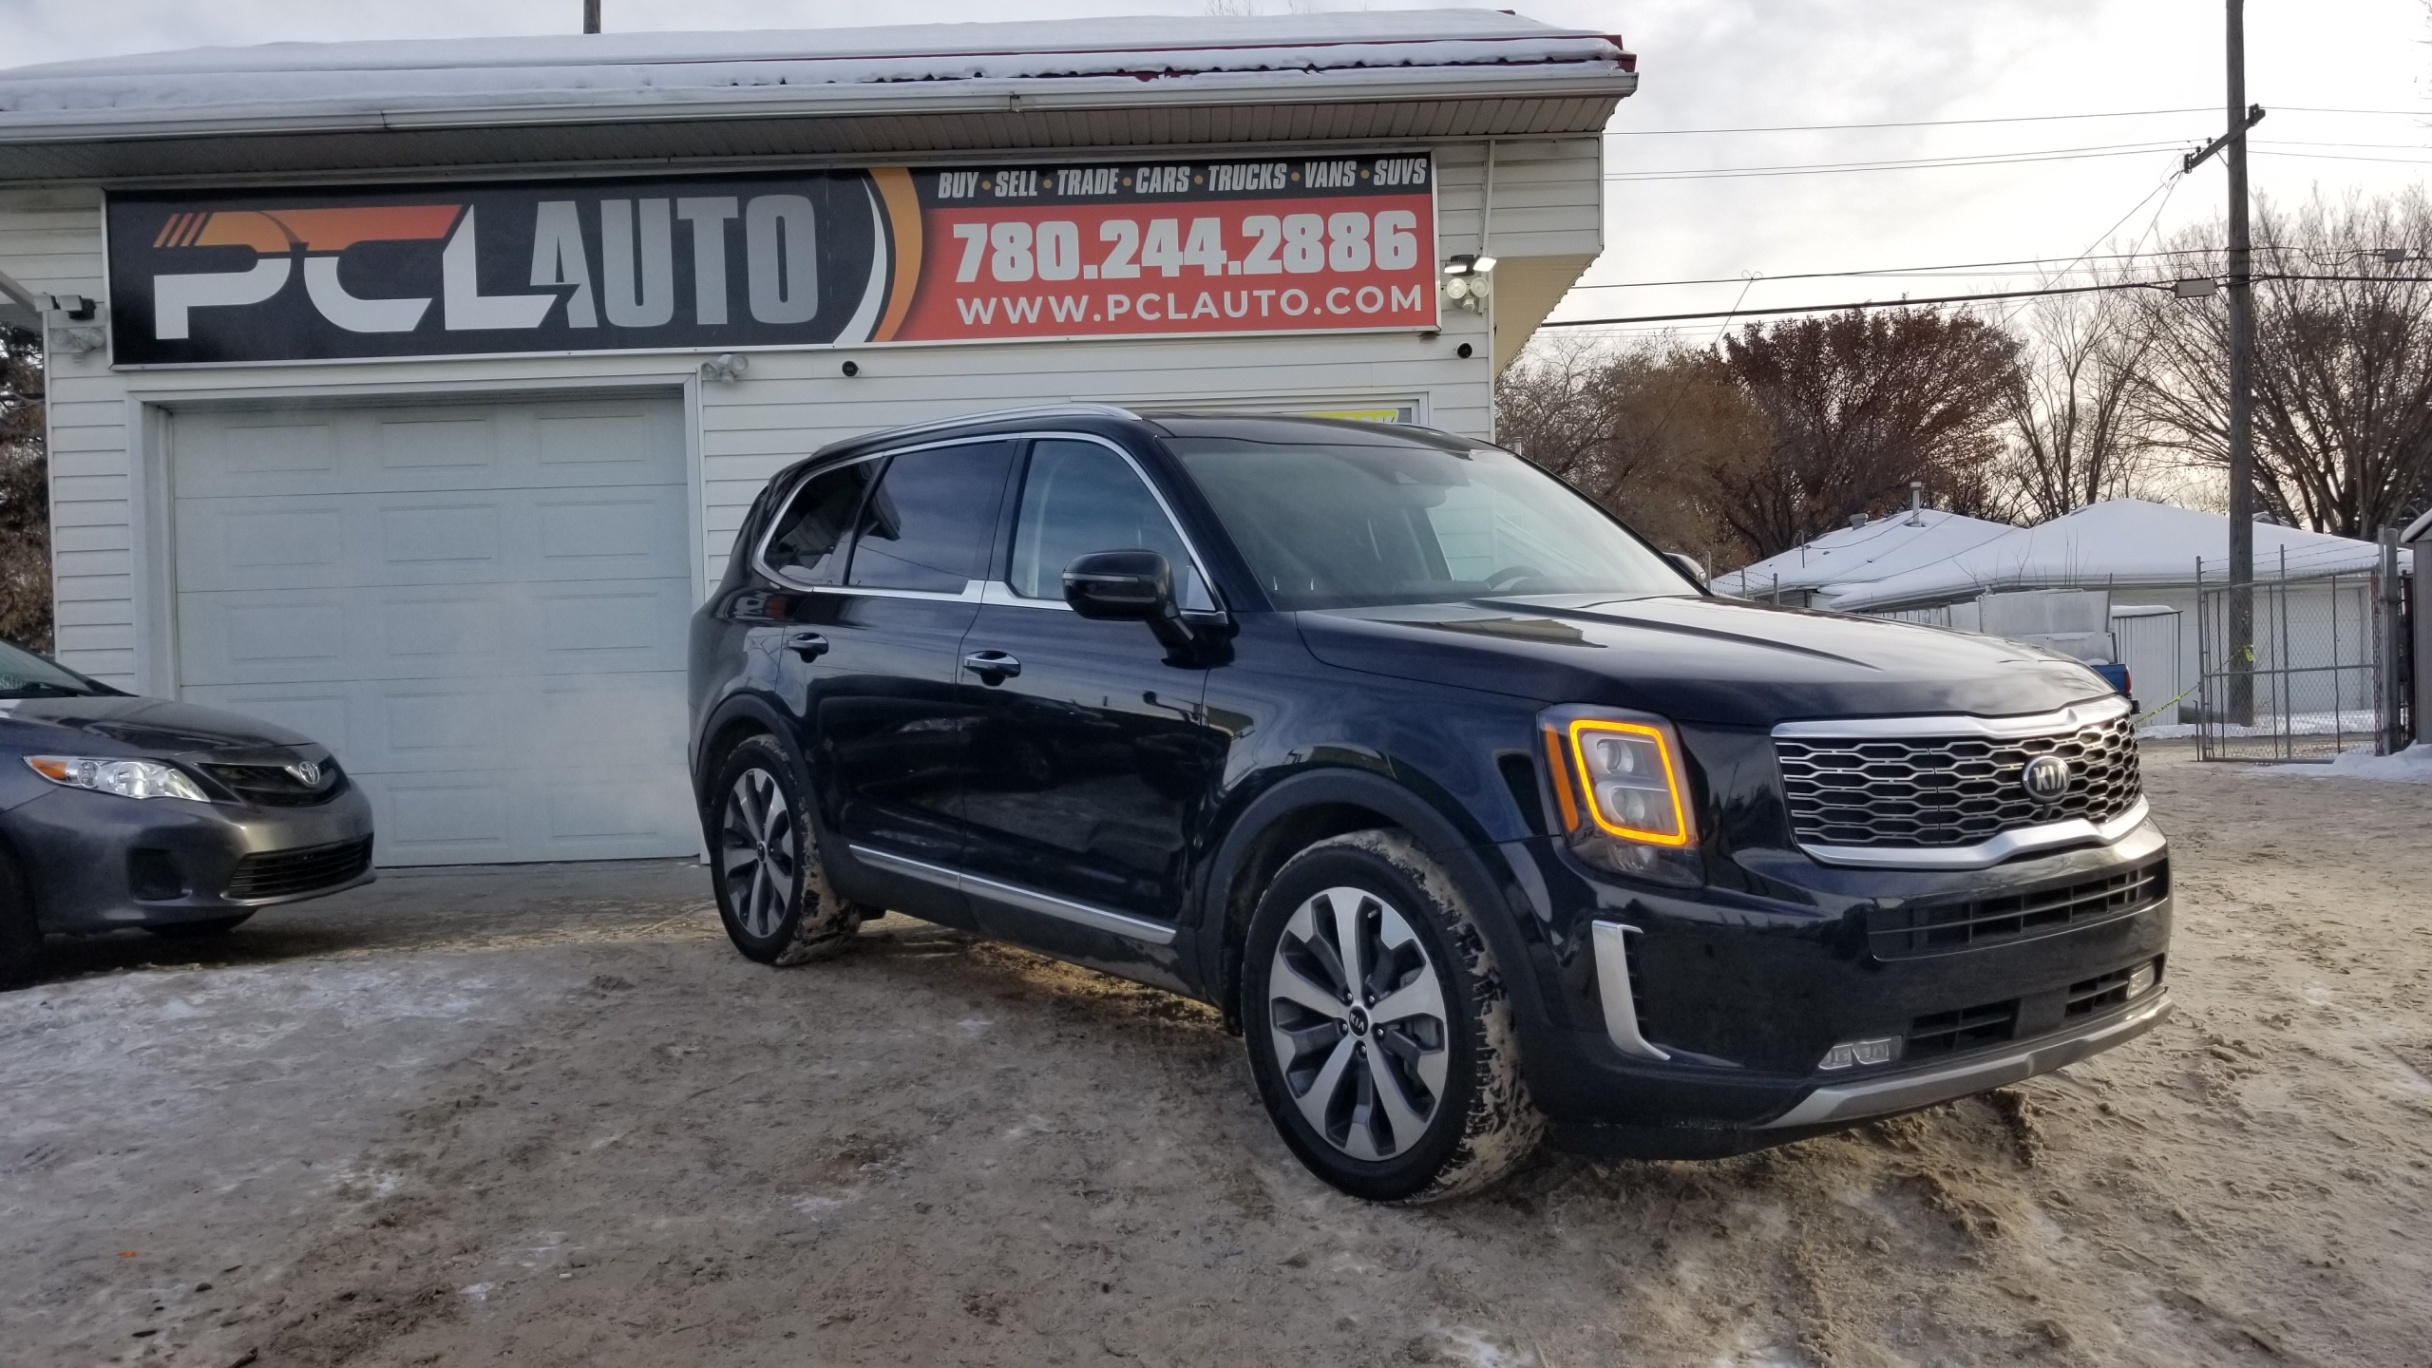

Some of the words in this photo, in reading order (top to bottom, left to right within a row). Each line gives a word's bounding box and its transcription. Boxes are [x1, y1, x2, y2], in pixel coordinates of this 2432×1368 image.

[938, 172, 979, 199] BUY
[995, 171, 1038, 197] SELL
[1057, 168, 1119, 196] TRADE
[1135, 166, 1190, 194] CARS
[1208, 163, 1287, 191] TRUCKS
[1304, 160, 1357, 188] VANS
[1373, 158, 1427, 186] SUVS
[953, 210, 1418, 283] 780.244.2886
[153, 203, 560, 341] PCL
[530, 194, 820, 329] AUTO
[956, 284, 1423, 325] WWW.PCLAUTO.COM
[2033, 764, 2067, 792] KIA
[1350, 1012, 1365, 1032] KIA
